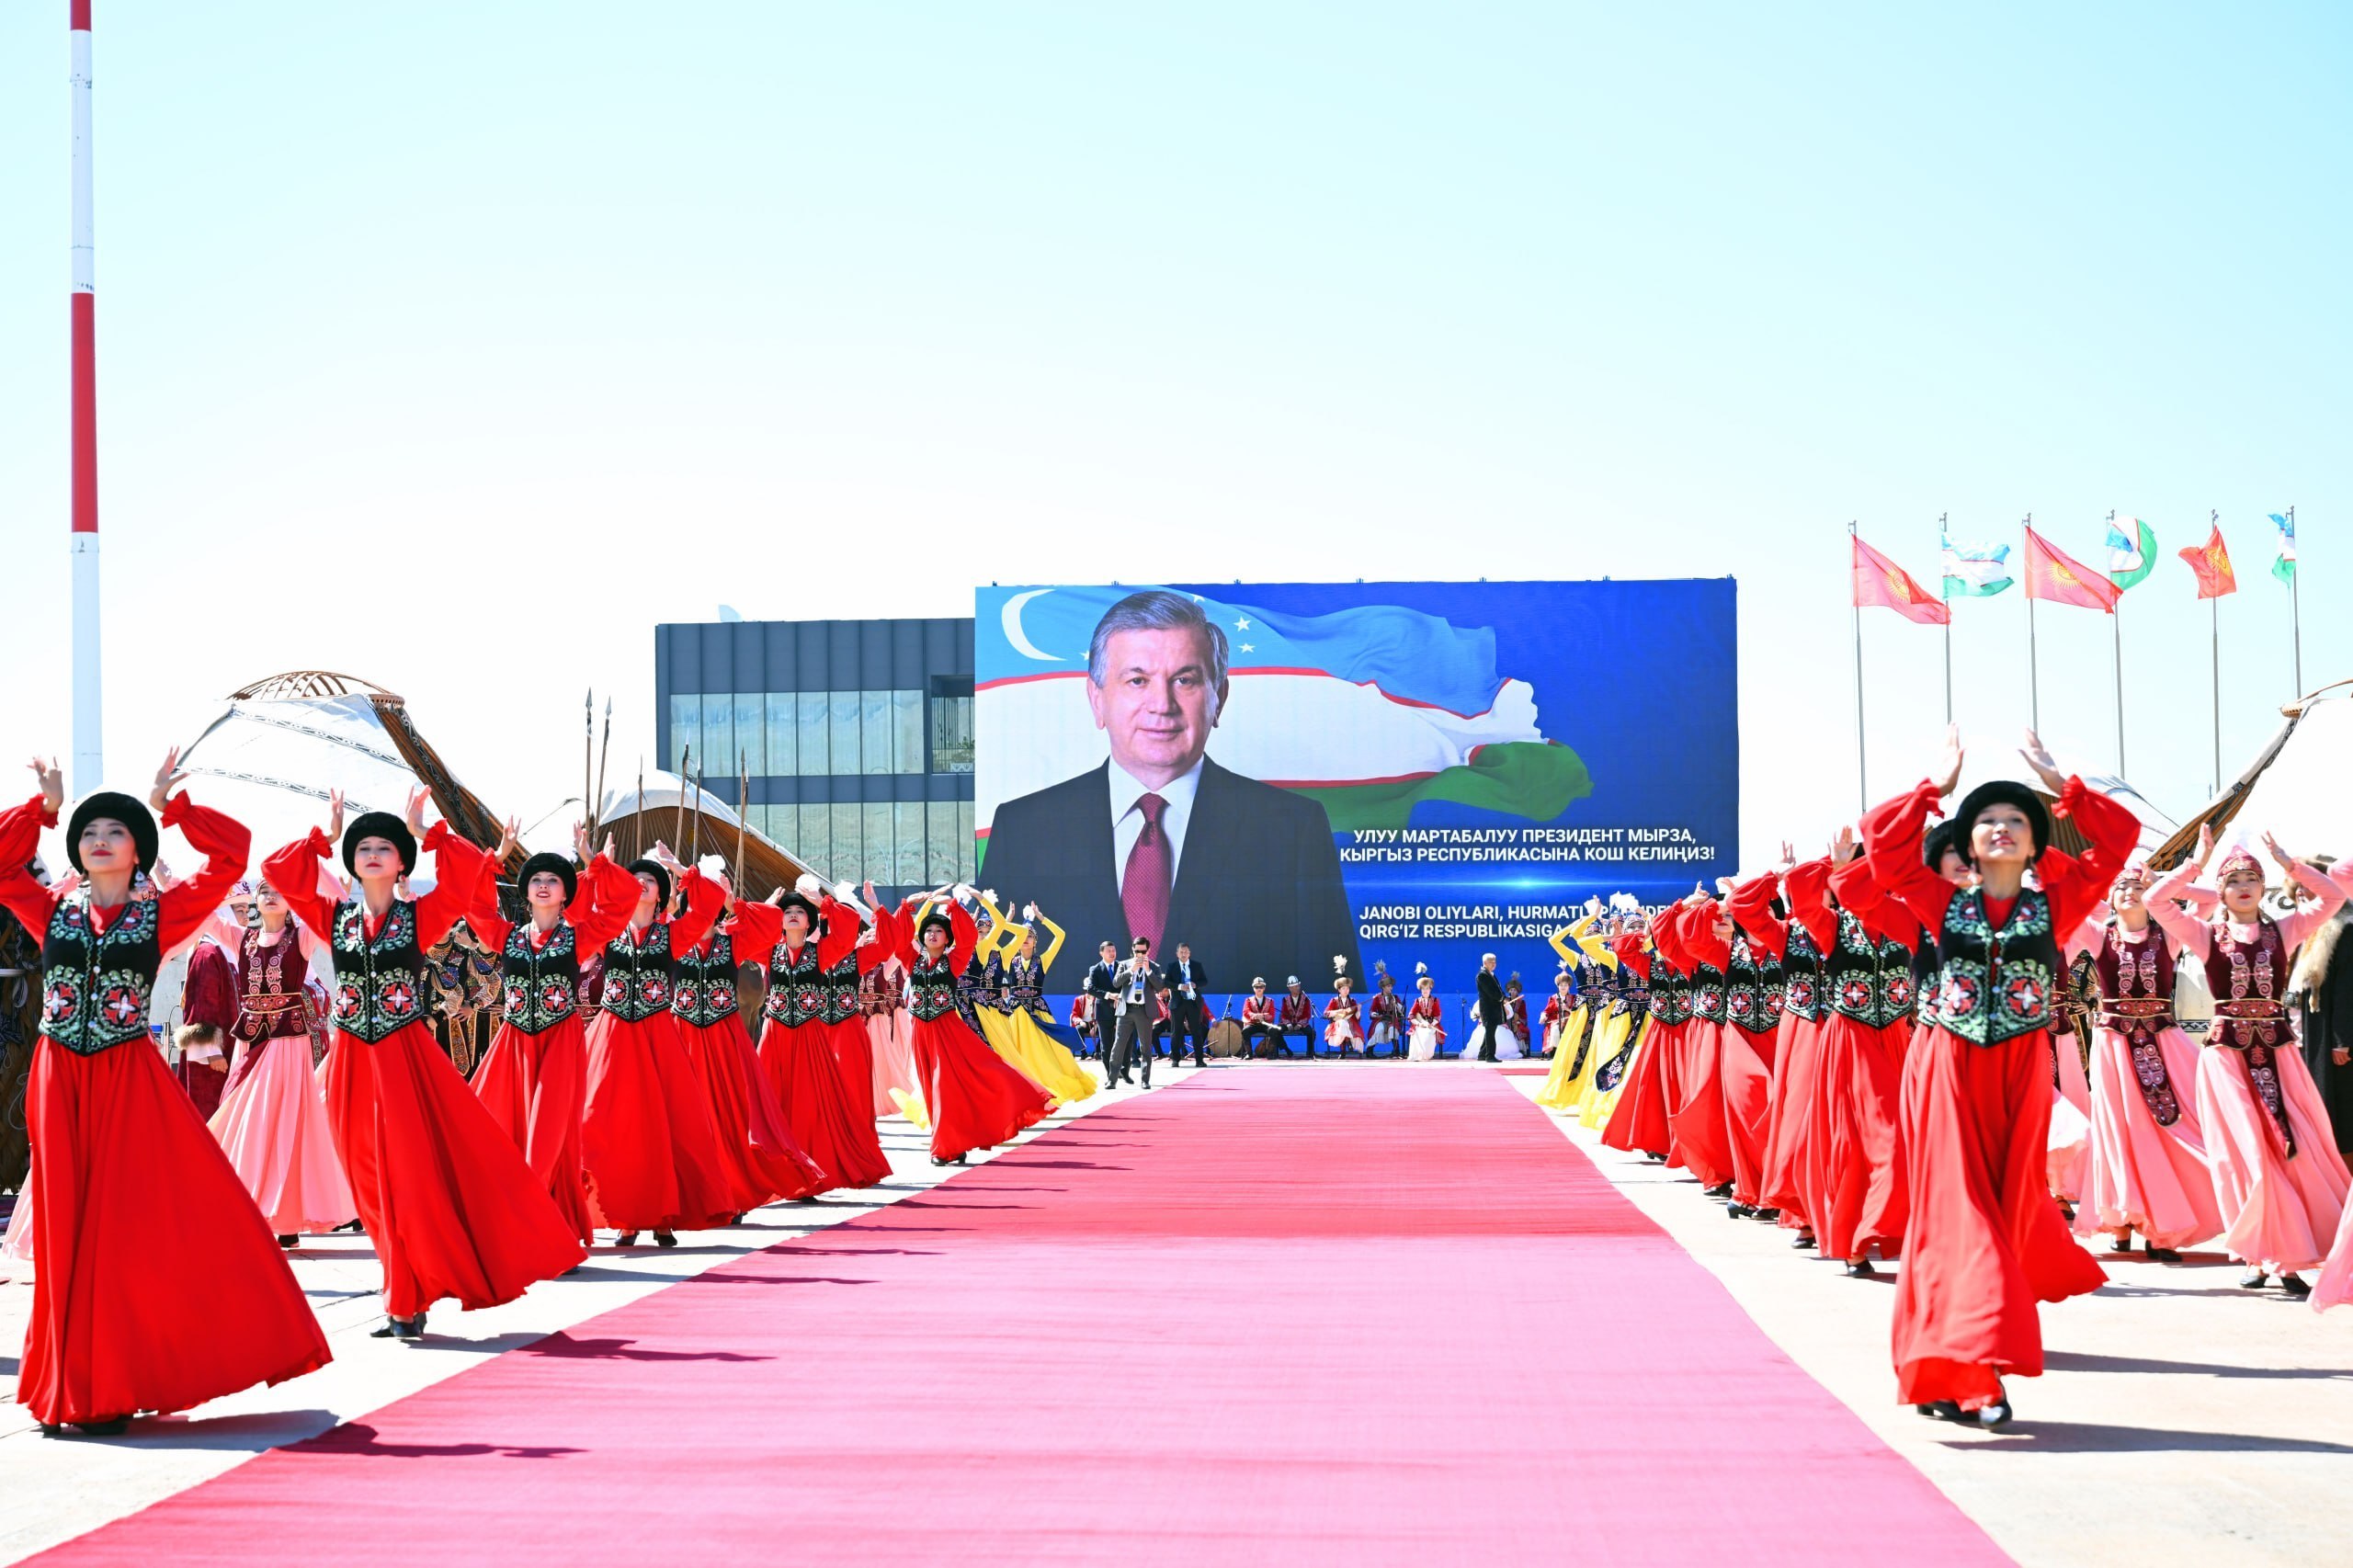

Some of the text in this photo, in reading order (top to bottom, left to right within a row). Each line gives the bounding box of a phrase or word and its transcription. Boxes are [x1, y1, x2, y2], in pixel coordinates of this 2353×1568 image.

[1354, 829, 1697, 845] УЛУУ МАРТАБАЛУУ ПРЕЗИДЕНТ МЫРЗА,
[1340, 846, 1715, 862] КЫРГЫЗ РЕСПУБЛИКАСЫНА КОШ КЕЛИҢИЗ!
[1359, 906, 1420, 920] JANOBI
[1425, 906, 1504, 922] OLIYLARI,
[1508, 906, 1591, 919] HURMATL
